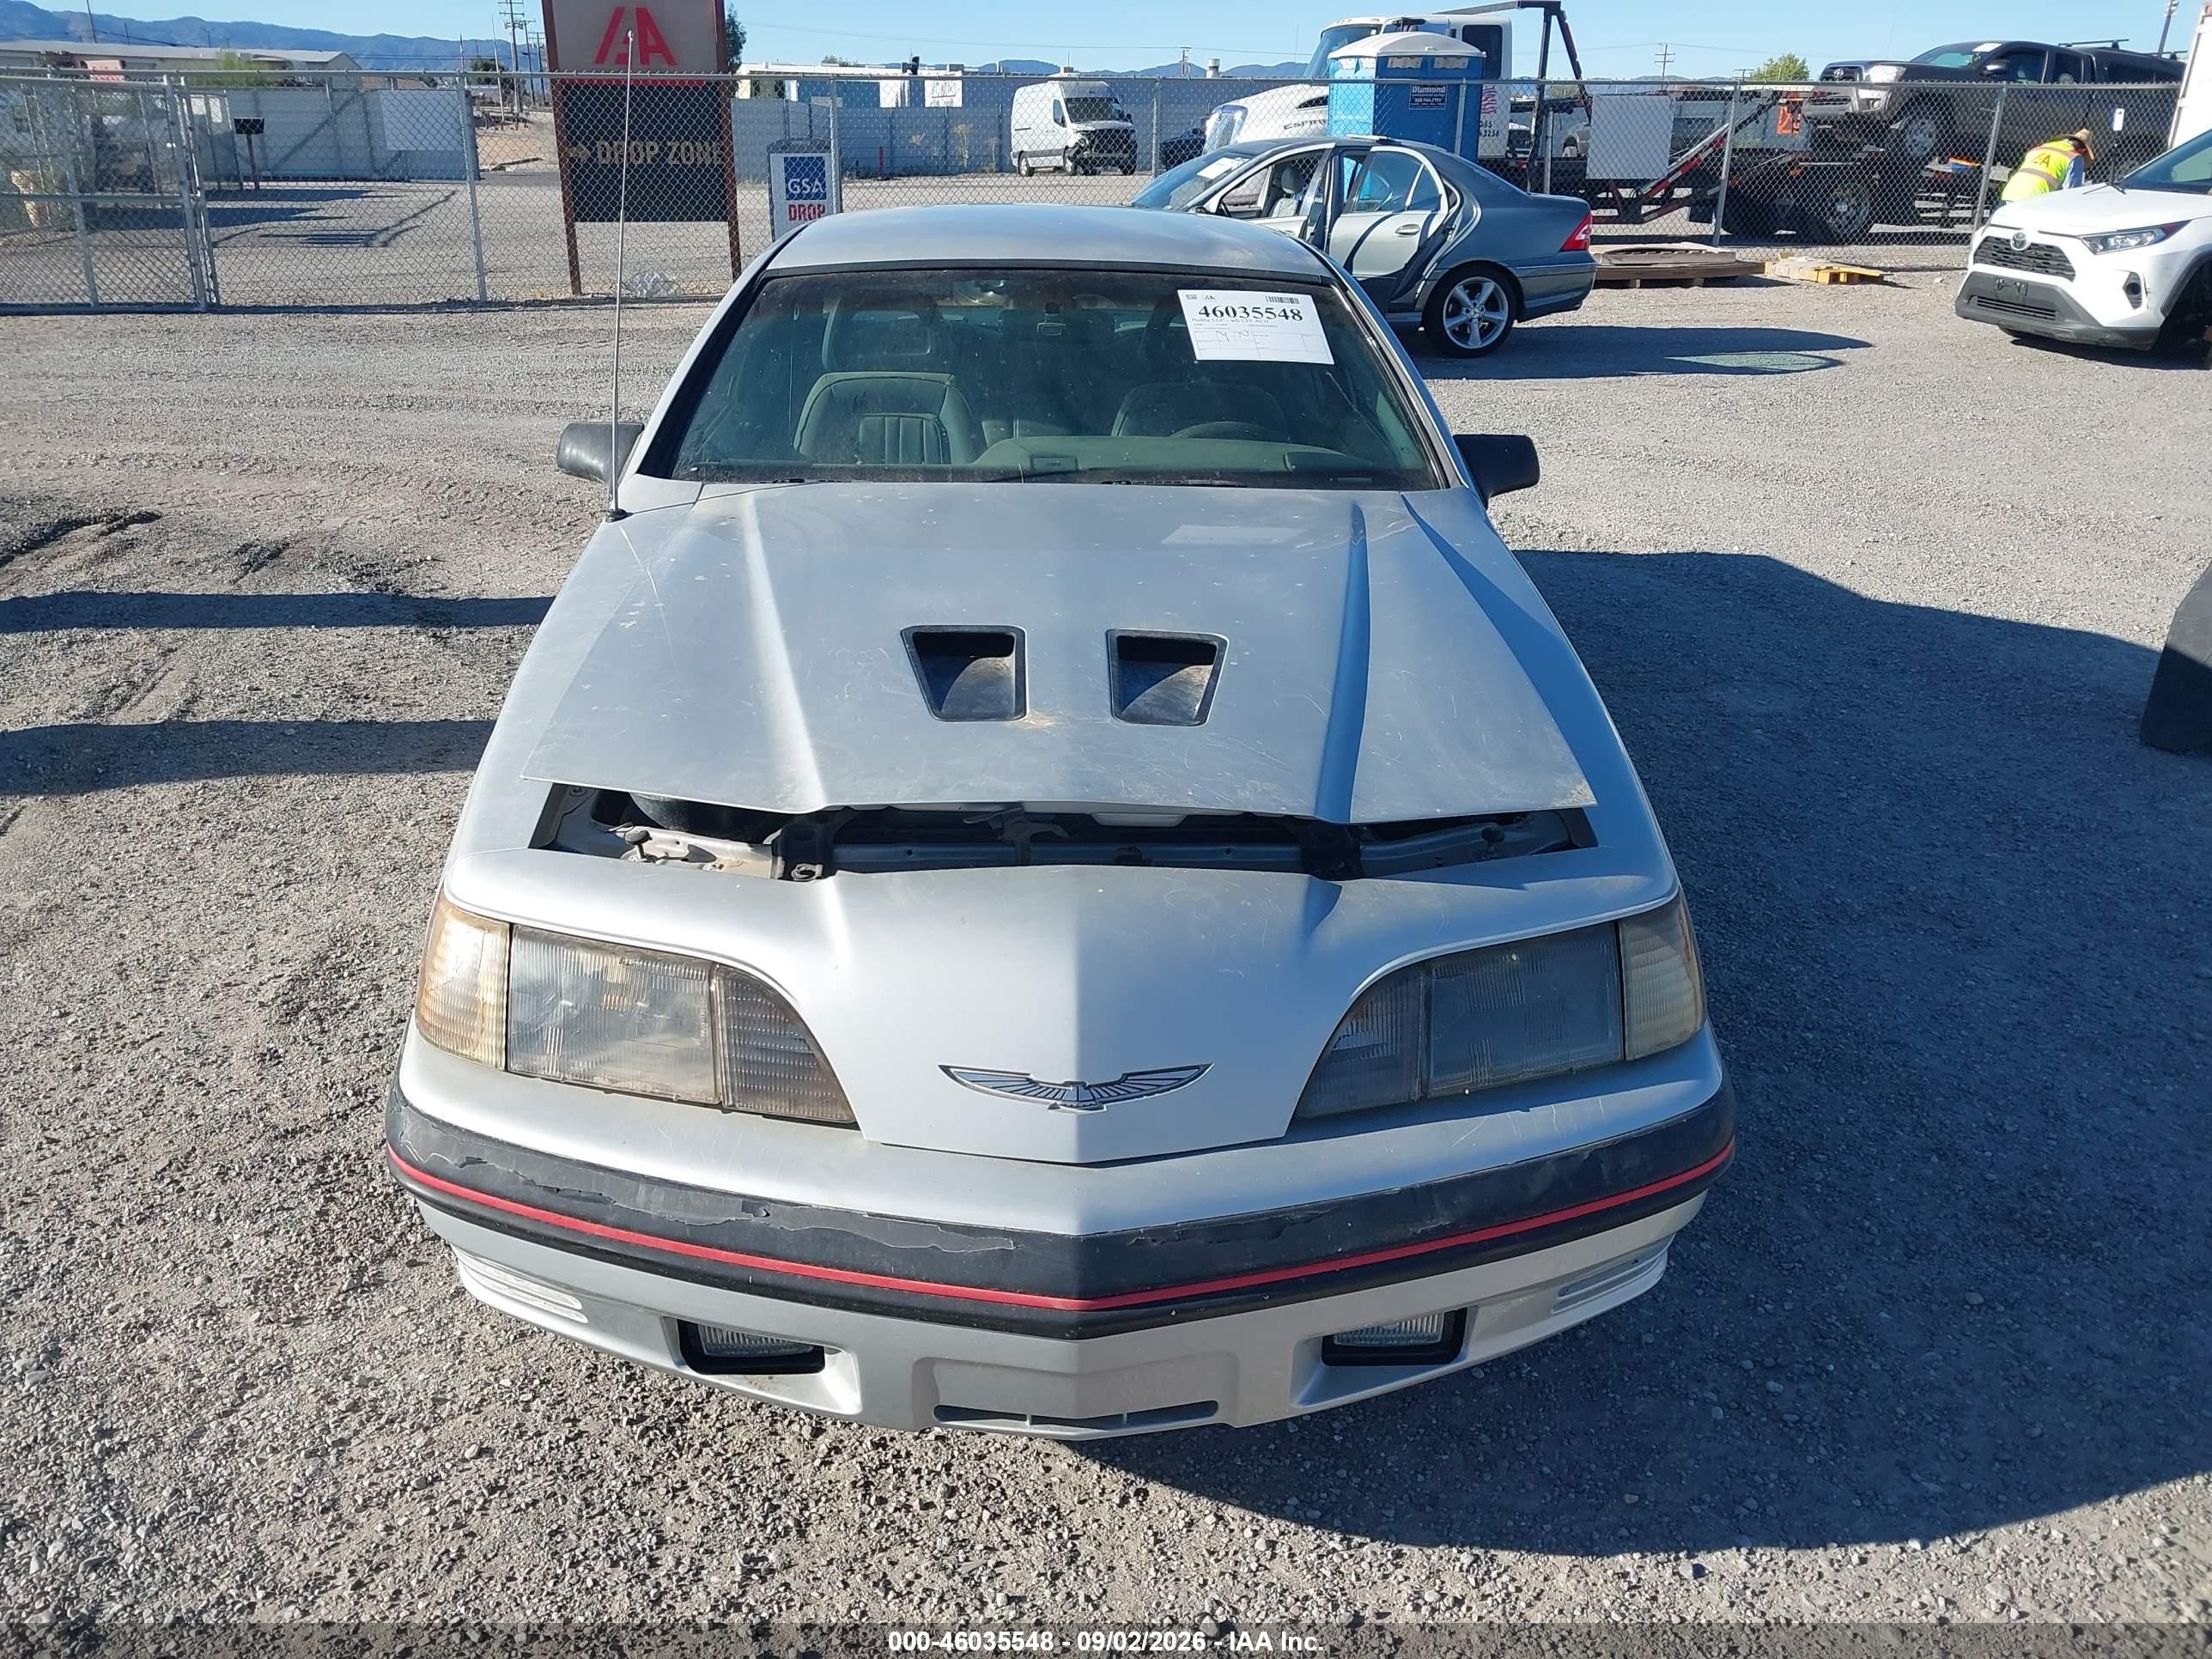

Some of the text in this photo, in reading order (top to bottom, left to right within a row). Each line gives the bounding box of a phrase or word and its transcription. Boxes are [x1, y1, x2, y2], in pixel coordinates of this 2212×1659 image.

[1412, 85, 1446, 94] Diamond
[597, 141, 723, 165] DROP ZONE
[788, 178, 825, 194] GSA
[788, 203, 825, 222] DROP
[1198, 305, 1304, 322] 46035548
